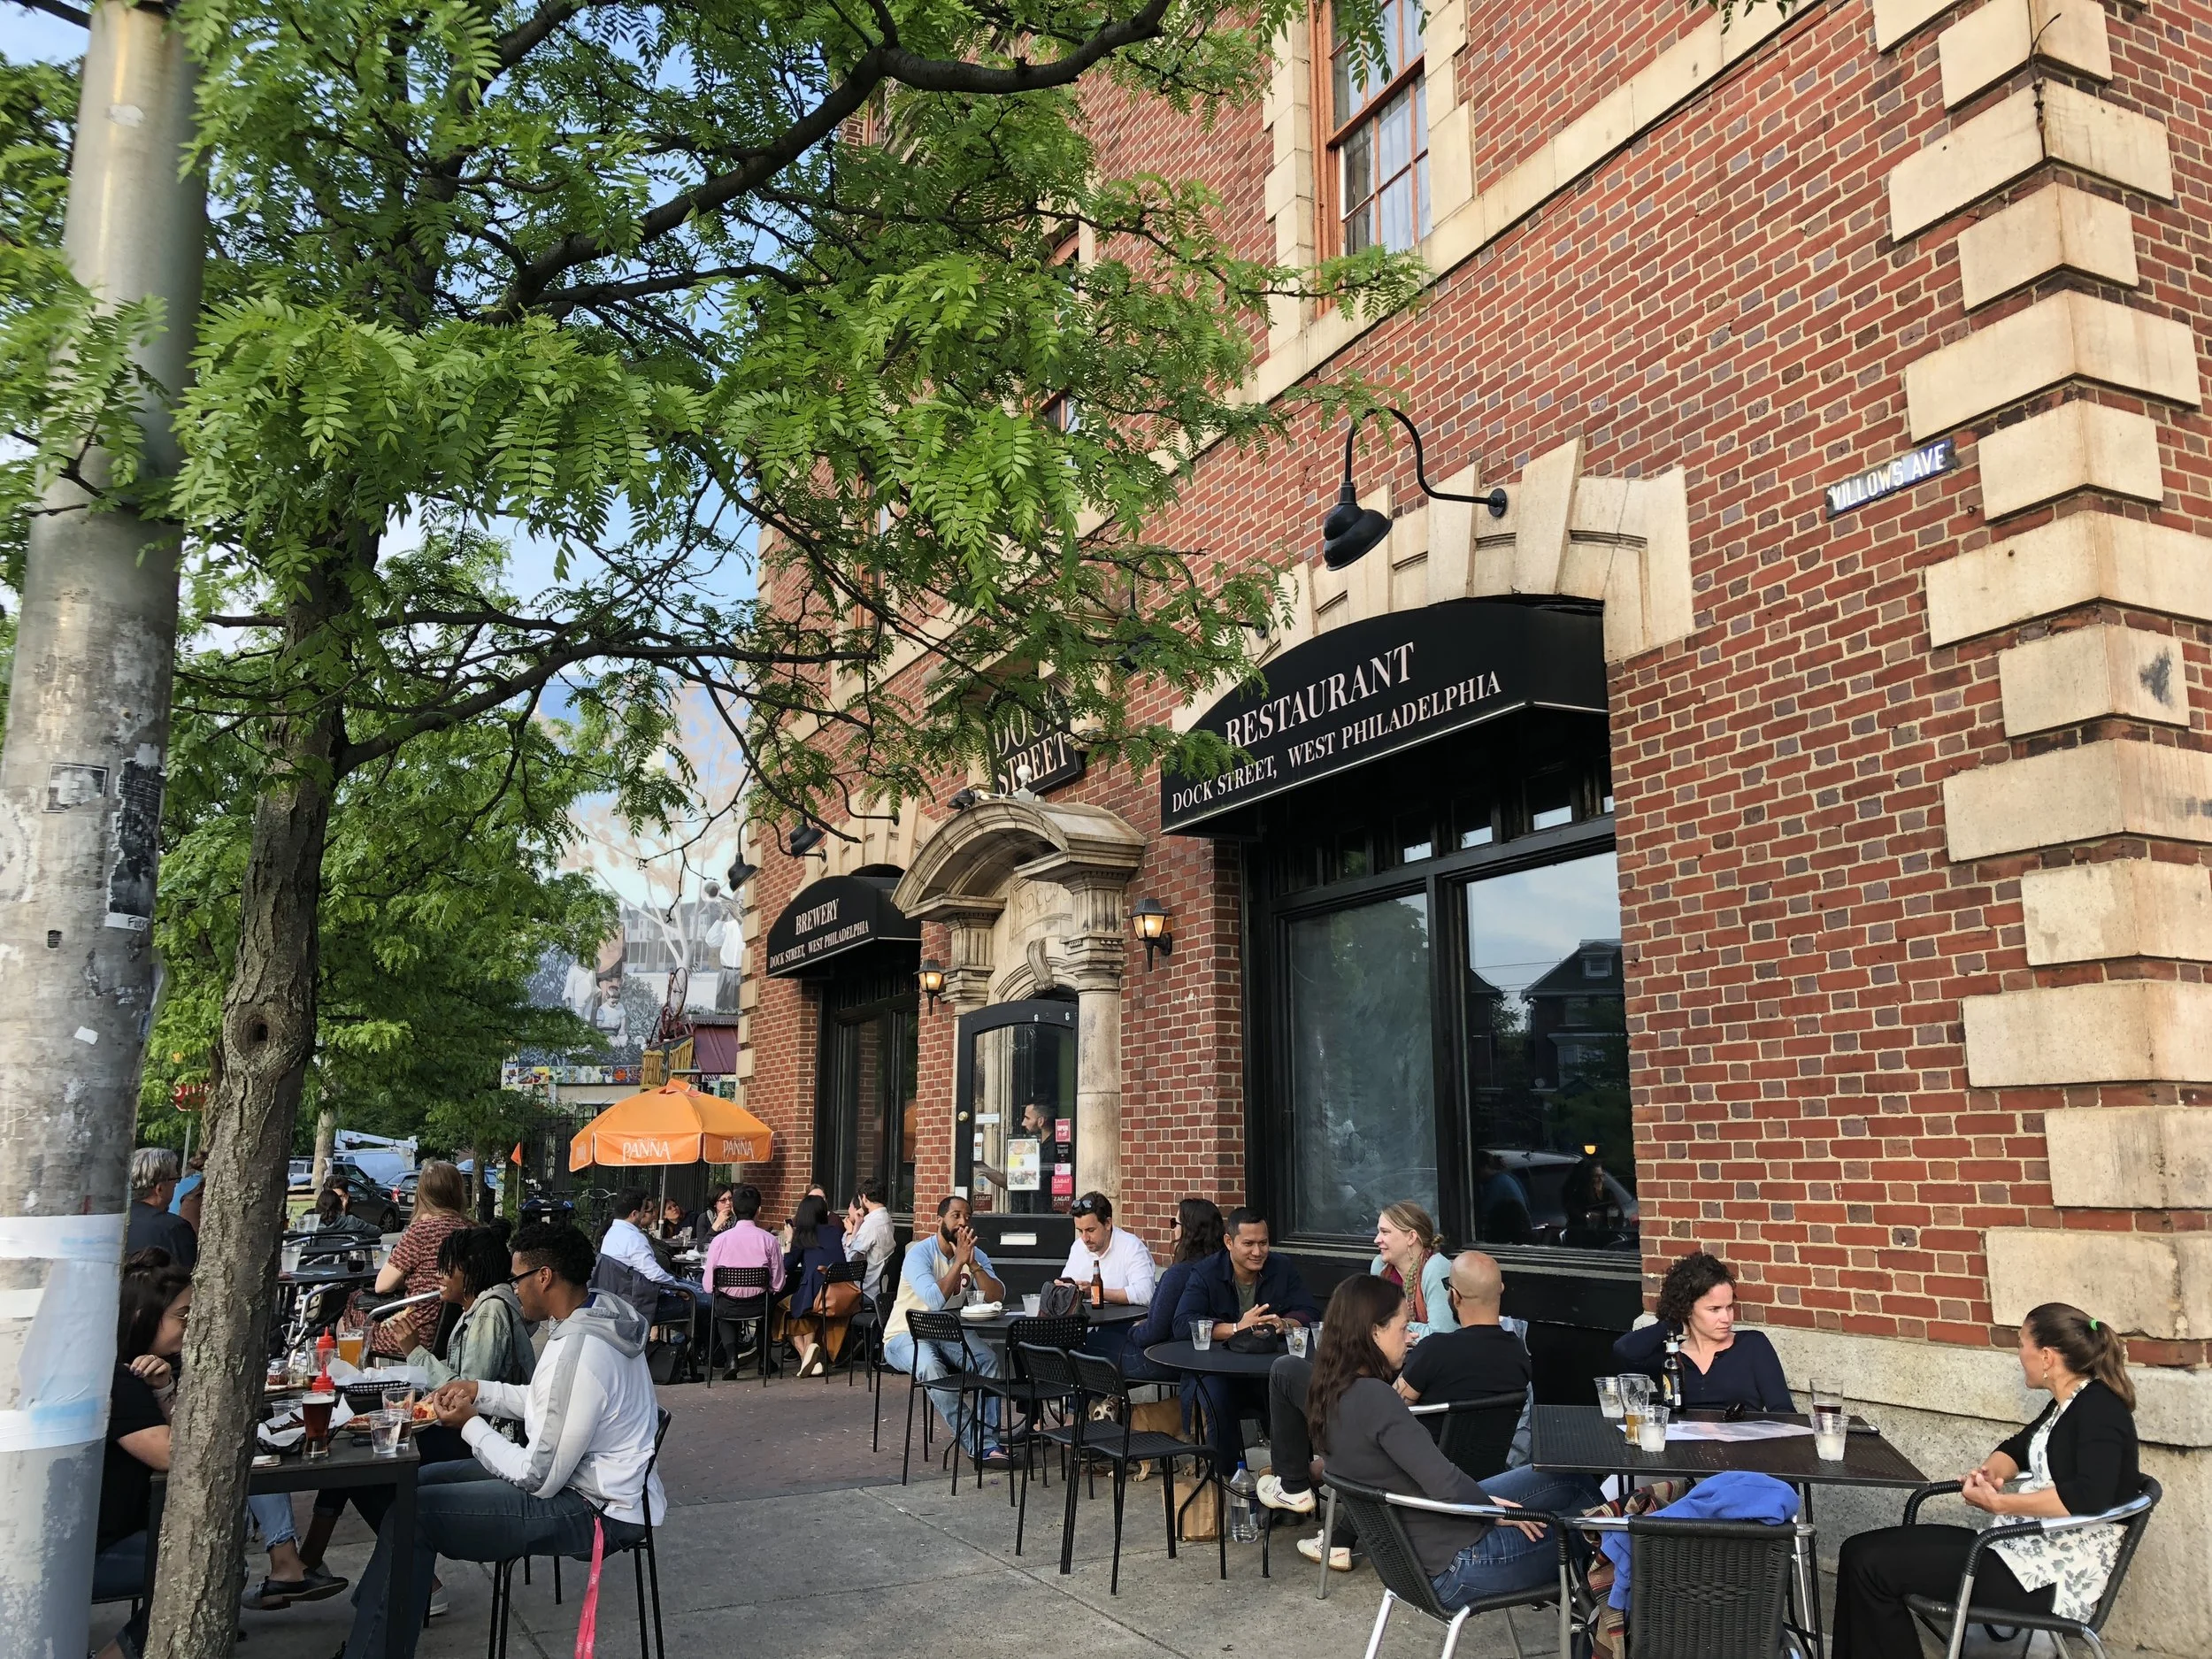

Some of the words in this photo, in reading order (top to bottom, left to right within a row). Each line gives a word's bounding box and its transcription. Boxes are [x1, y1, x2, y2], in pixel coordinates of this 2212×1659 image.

[1911, 443, 1947, 480] AVE
[1225, 641, 1415, 749] RESTAURANT
[1172, 779, 1213, 812] DOCK
[1217, 755, 1278, 796] STREET,
[1286, 732, 1336, 769] WEST
[1341, 670, 1502, 749] PHILADELPHIA
[997, 731, 1068, 797] STREET
[795, 898, 839, 935] BREWERY
[770, 953, 785, 969] DOCK
[785, 943, 806, 964] STREET,
[808, 938, 824, 954] WEST
[824, 920, 869, 948] PHILADELPHIA
[622, 1141, 672, 1163] PANNA
[722, 1140, 755, 1160] PANNA
